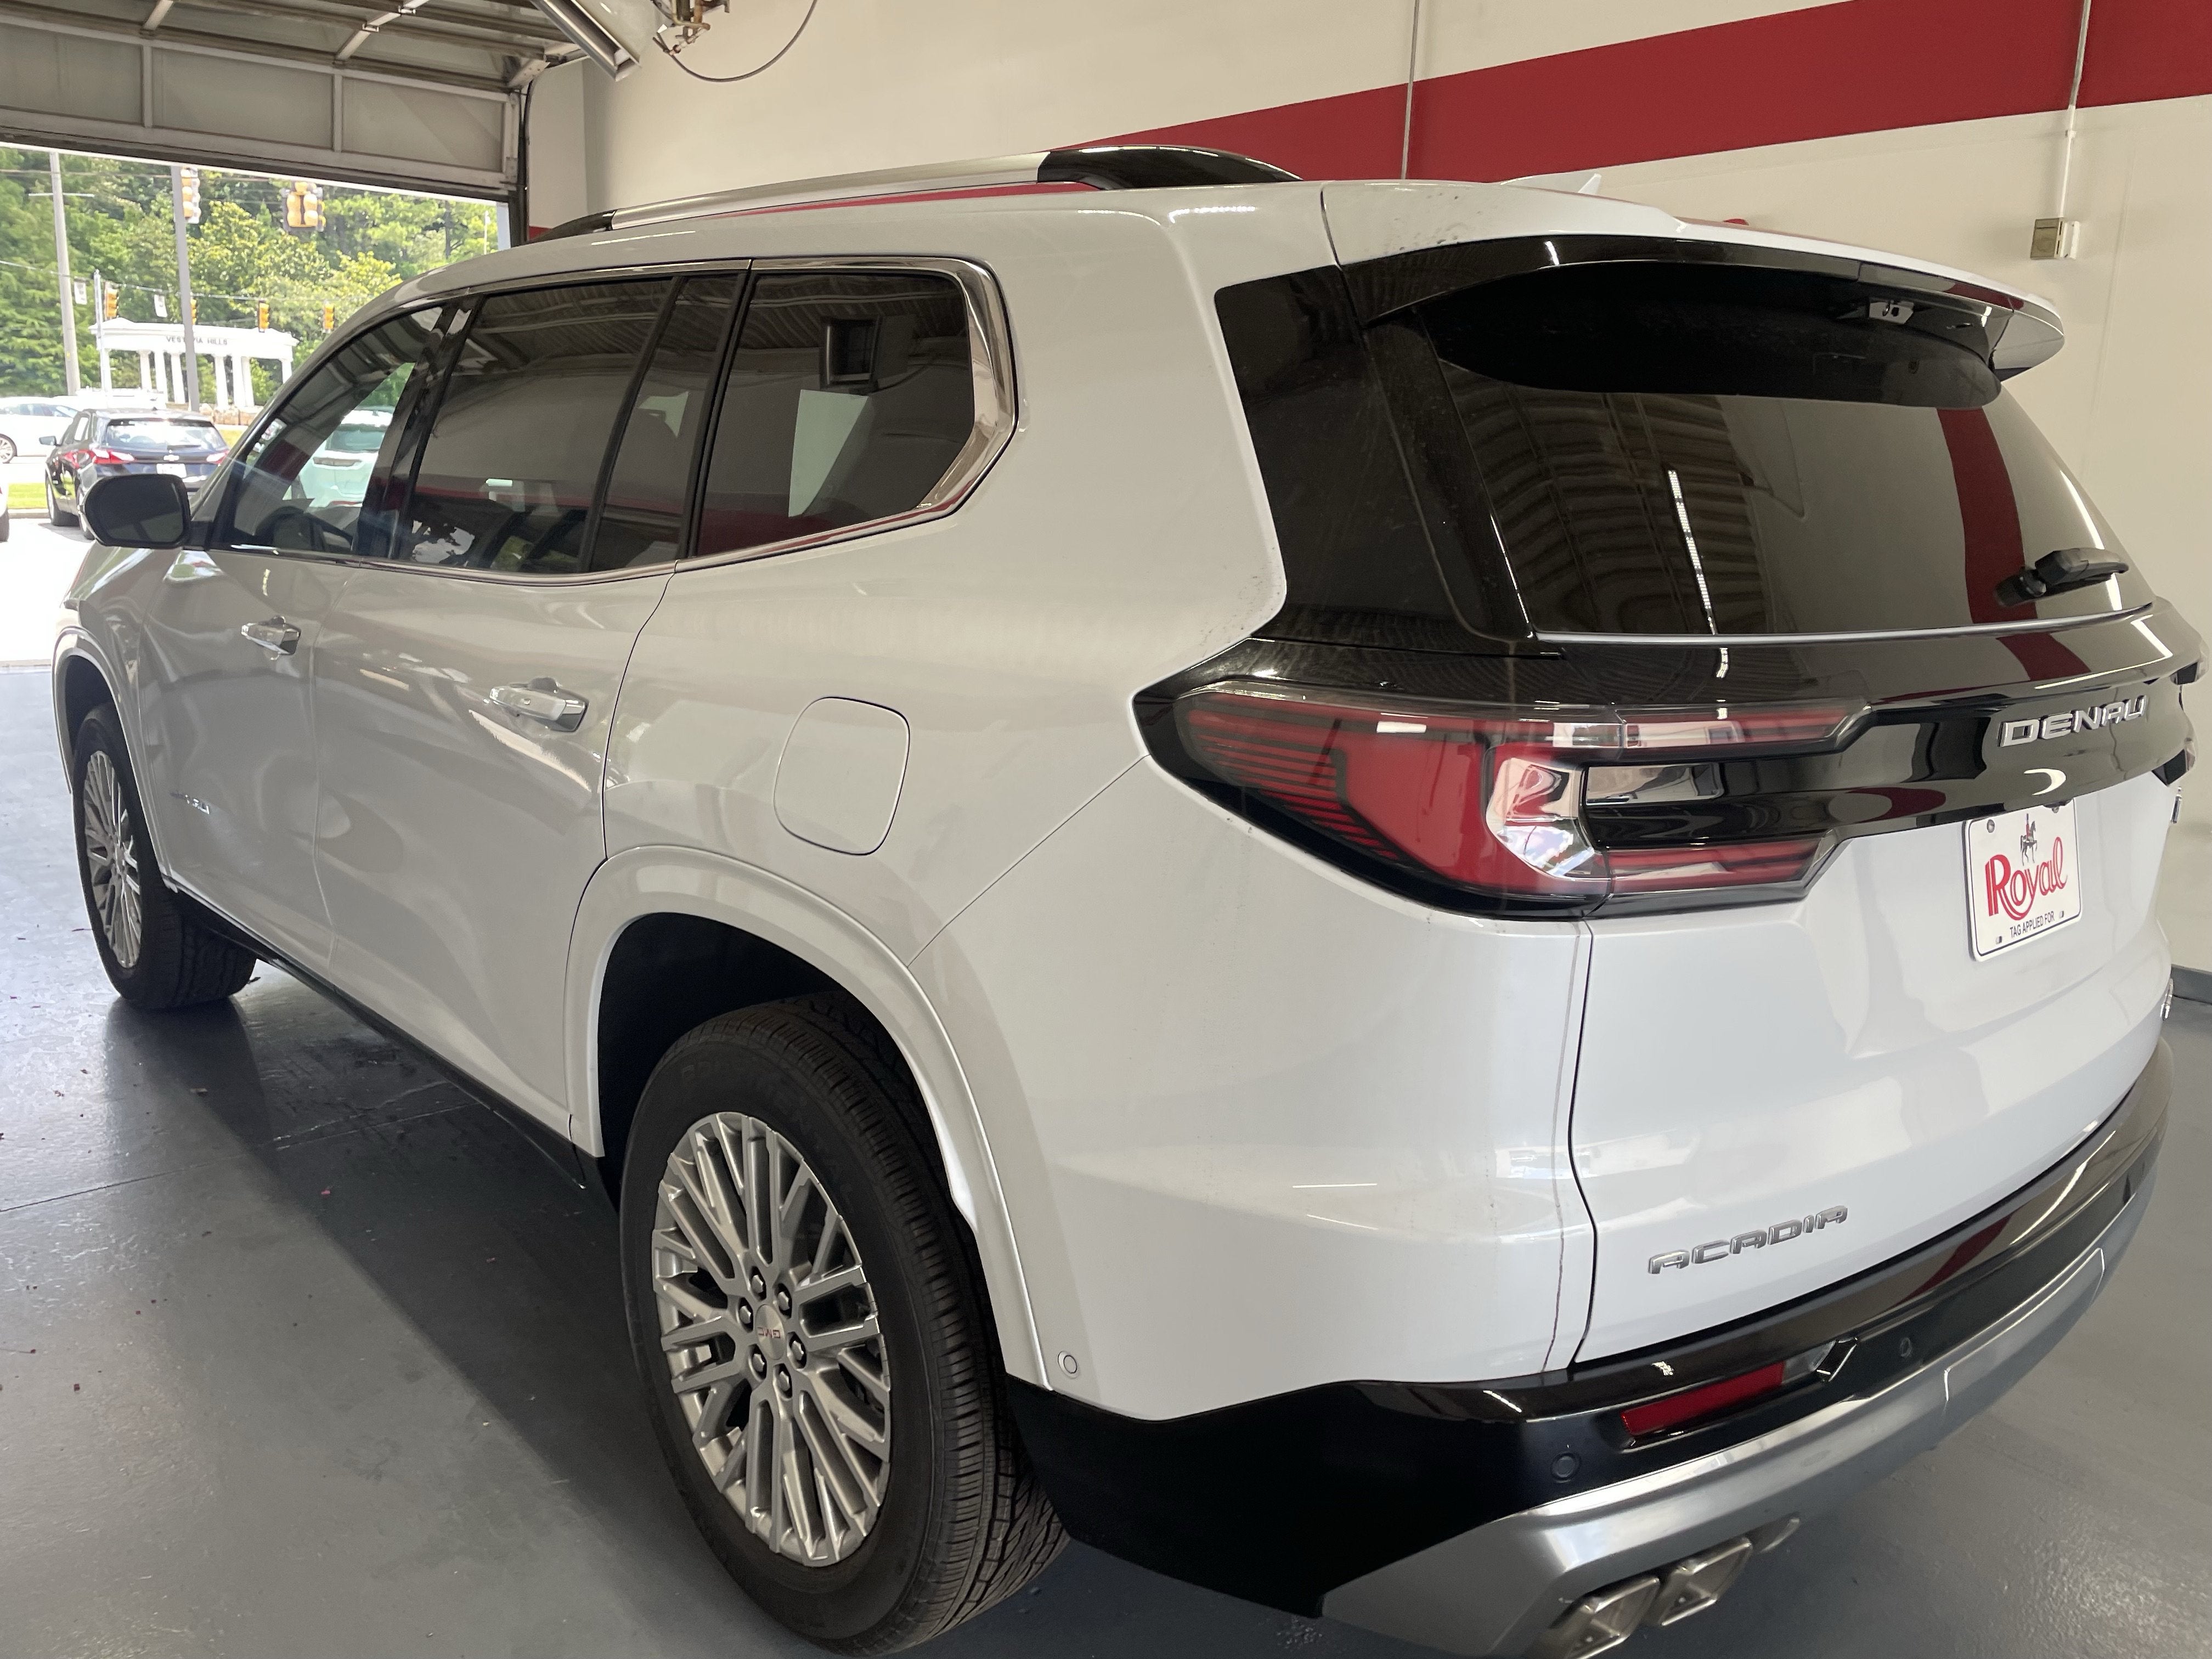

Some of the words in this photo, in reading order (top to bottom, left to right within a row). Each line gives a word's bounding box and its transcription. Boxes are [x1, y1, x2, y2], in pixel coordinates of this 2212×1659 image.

[1997, 695, 2147, 747] DENALI
[1985, 836, 2068, 921] Royal
[2010, 924, 2022, 938] TAG
[2022, 915, 2044, 934] APPLIED
[2045, 911, 2055, 924] FOR
[1648, 1205, 1848, 1274] ACADIA
[757, 1327, 781, 1339] GMC
